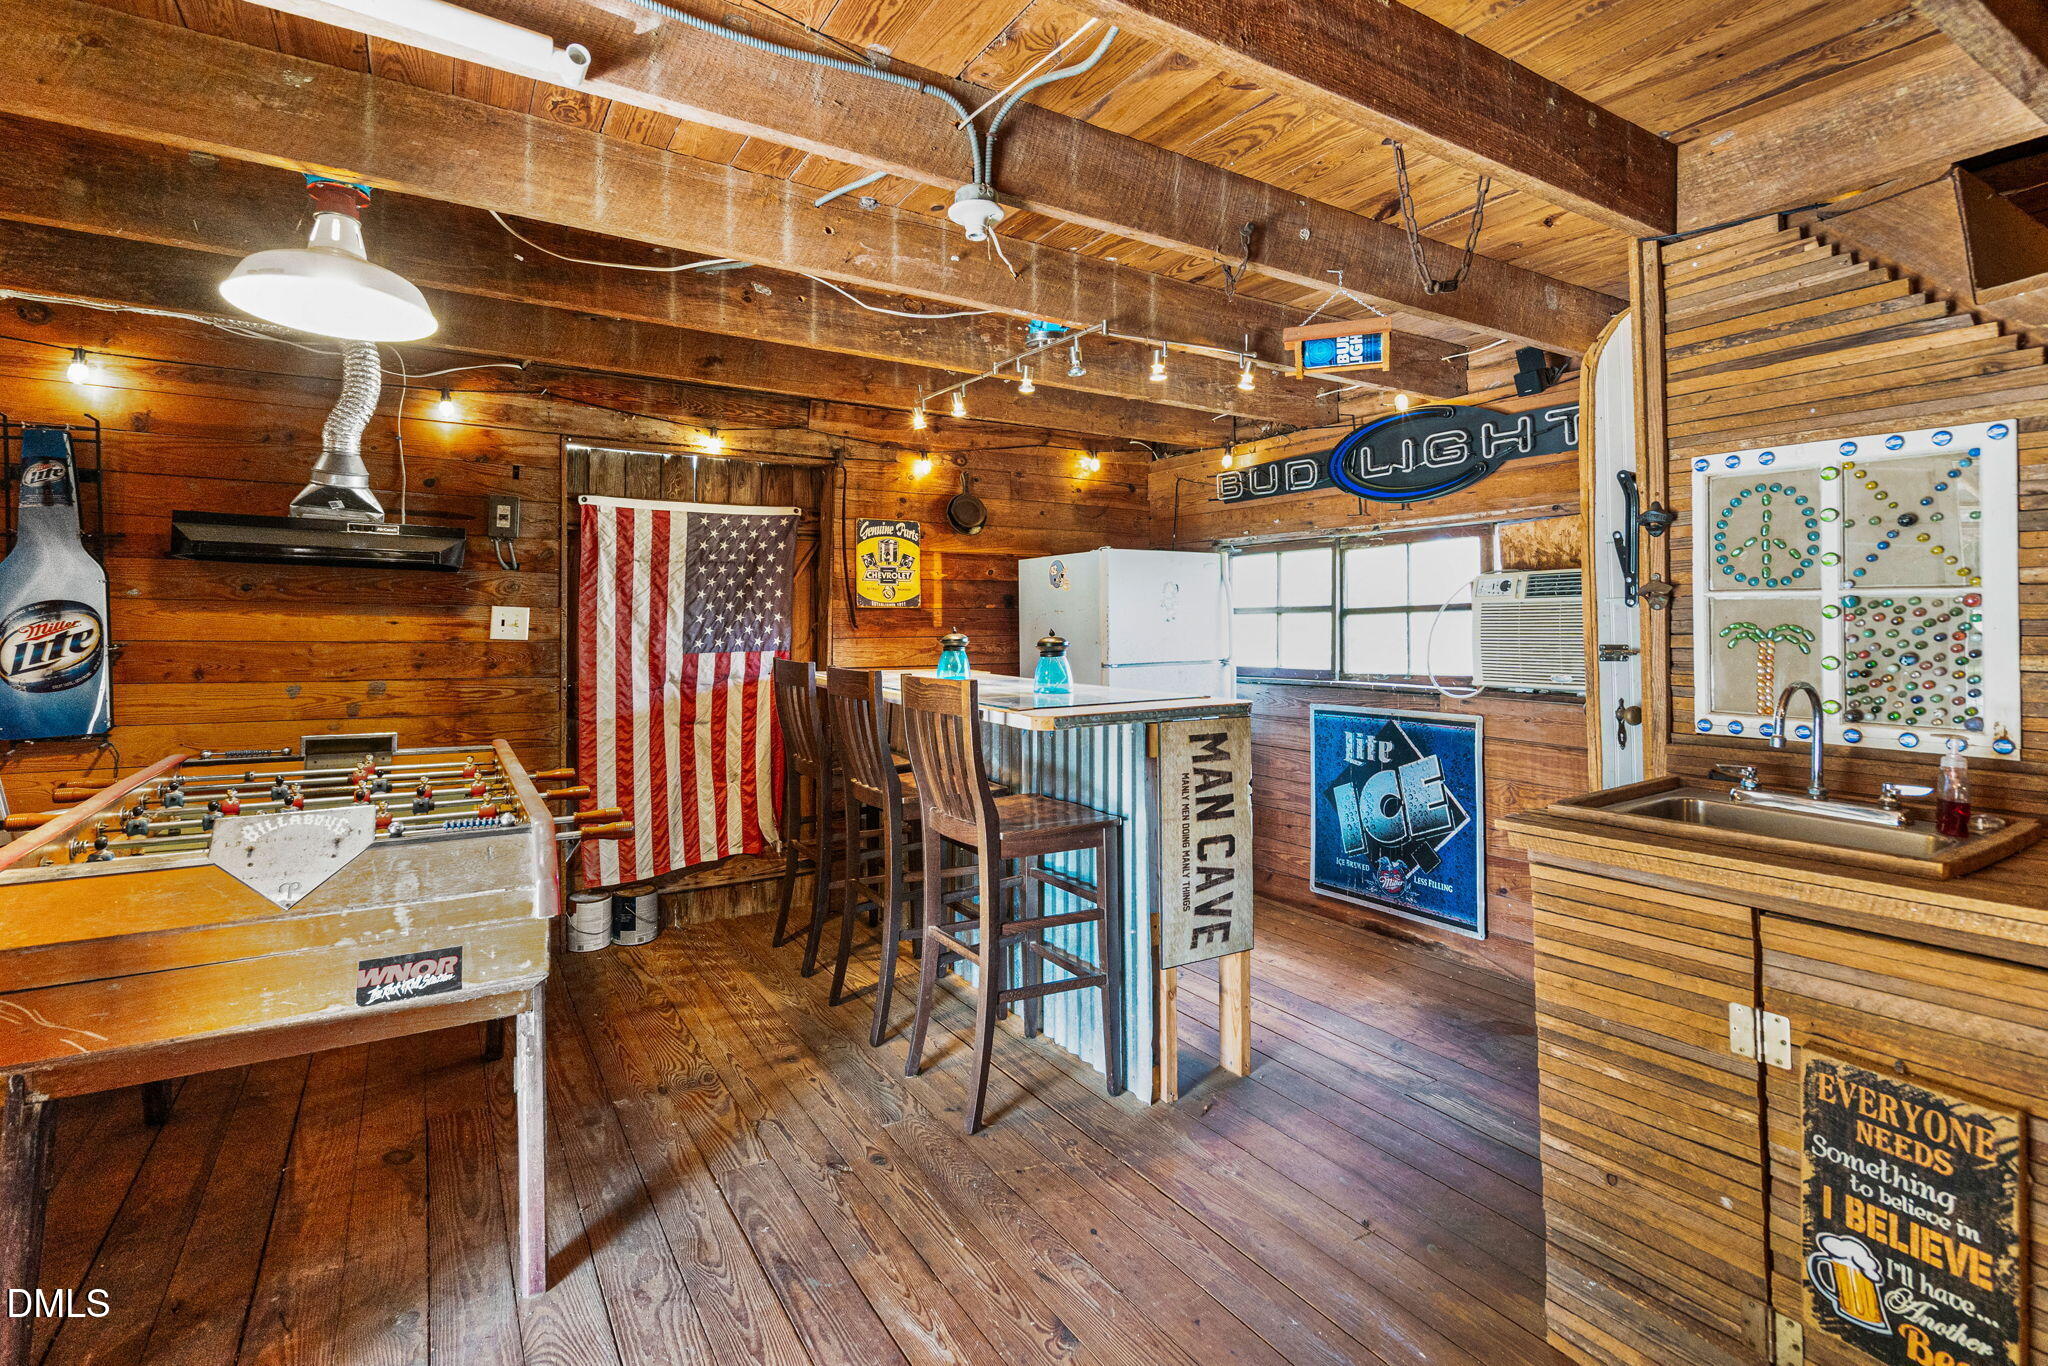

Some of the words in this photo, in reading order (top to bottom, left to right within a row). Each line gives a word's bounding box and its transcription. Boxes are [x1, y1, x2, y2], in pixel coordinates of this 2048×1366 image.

[1216, 458, 1318, 500] BUD
[1360, 405, 1580, 479] LIGHT
[859, 520, 895, 540] Genuine
[895, 522, 919, 542] Parts
[866, 571, 911, 580] CHEVROLET
[18, 620, 82, 641] Miller
[9, 629, 94, 676] Lite
[1343, 731, 1394, 767] Lite
[1181, 772, 1190, 801] MANLY
[1188, 732, 1235, 822] MAN
[1181, 803, 1190, 821] MEN
[1333, 754, 1454, 855] ICE
[1181, 823, 1190, 849] DOING
[1182, 850, 1191, 879] MANLY
[1182, 881, 1191, 913] THINGS
[1189, 834, 1236, 950] CAVE
[1414, 876, 1428, 887] LESS
[1428, 879, 1454, 893] FILLING
[357, 955, 459, 989] WNOR
[1817, 1073, 1998, 1162] EVERYONE
[1856, 1119, 1954, 1176] NEEDS
[1811, 1134, 1957, 1215] Something
[1850, 1174, 1874, 1198] to
[1879, 1186, 1951, 1231] believe
[1956, 1218, 1982, 1244] in
[1822, 1185, 1832, 1220] I
[1845, 1194, 1994, 1292] BELIEVE
[1886, 1257, 1914, 1290] I'll
[1884, 1287, 1994, 1356] Another
